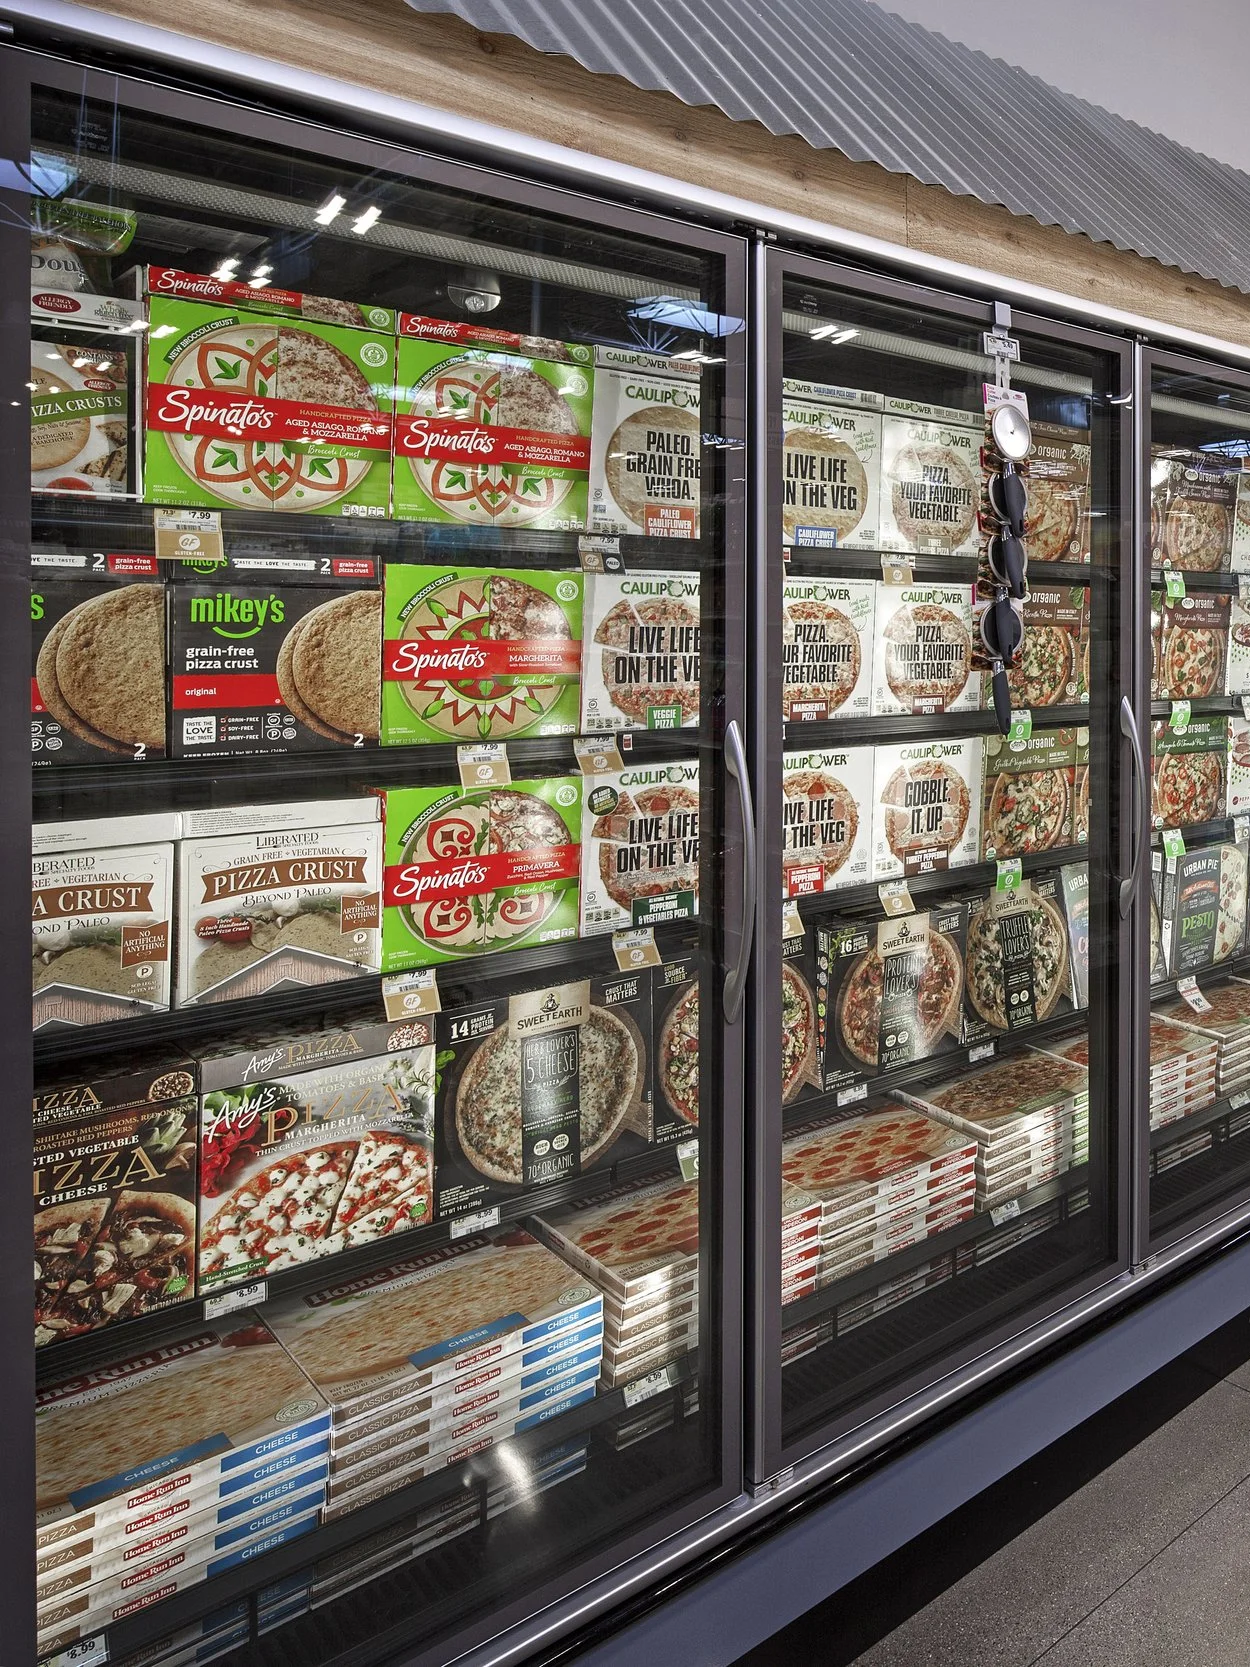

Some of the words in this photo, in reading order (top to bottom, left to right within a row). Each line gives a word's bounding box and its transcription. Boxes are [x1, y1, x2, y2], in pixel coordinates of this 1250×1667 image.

[168, 345, 183, 361] NEW
[182, 325, 210, 347] BROCCOLI
[211, 319, 233, 330] CRUST
[158, 389, 274, 431] Spinato's
[300, 409, 352, 420] HANDCRAFTED
[310, 429, 368, 441] MOZZARELLA
[647, 431, 694, 456] PALEO.
[308, 445, 337, 455] Broccoli
[340, 448, 360, 458] Crust
[504, 443, 525, 452] AGED
[525, 446, 553, 455] ASIAGO,
[554, 449, 585, 459] ROMANO
[787, 452, 819, 480] LIVE
[820, 456, 848, 484] LIFE
[645, 476, 695, 500] WHOA.
[801, 484, 828, 509] THE
[831, 485, 858, 511] VEG
[900, 480, 927, 502] YOUR
[928, 483, 972, 506] FAVORITE
[660, 509, 680, 519] PALEO
[648, 518, 691, 530] CAULIFLOWER
[181, 538, 197, 546] GF
[92, 553, 105, 568] 2
[320, 558, 331, 571] 2
[900, 589, 963, 604] CAULIPOWER
[190, 593, 285, 626] mikey's
[794, 625, 829, 643] PIZZA.
[915, 625, 944, 643] PIZZA.
[185, 645, 255, 659] grain-free
[392, 642, 487, 678] Spinato's
[802, 644, 852, 663] FAVORITE
[894, 644, 921, 662] YOUR
[923, 643, 964, 661] FAVORITE
[185, 658, 222, 671] pizza
[224, 657, 259, 669] crust
[904, 662, 955, 680] VEGETABLE.
[185, 687, 217, 697] original
[653, 709, 676, 719] VEGGIE
[186, 726, 213, 735] LOVE
[655, 719, 674, 729] PIZZA
[1187, 722, 1210, 734] organic
[478, 767, 492, 777] GF
[905, 778, 951, 808] GOBBLE.
[809, 799, 834, 823] LIFE
[629, 817, 663, 844] LIVE
[668, 813, 698, 840] LIFE
[911, 810, 924, 834] IT.
[926, 808, 943, 832] UP.
[255, 831, 319, 848] LIBERATED
[790, 824, 818, 849] THE
[820, 820, 845, 843] VEG
[233, 854, 261, 866] GRAIN
[262, 852, 282, 863] FREE
[291, 847, 340, 857] VEGETARIAN
[512, 861, 560, 873] PRIMAVERA
[1183, 859, 1207, 878] URBAN
[1208, 860, 1218, 870] PIE
[61, 872, 121, 886] VEGETARIAN
[213, 865, 279, 896] PIZZA
[288, 860, 358, 882] CRUST
[393, 860, 488, 900] Spinato's
[58, 887, 142, 913] CRUST
[242, 892, 291, 908] BEYOND
[293, 886, 332, 902] PALEO
[650, 901, 678, 912] PEPPERONI
[1001, 916, 1028, 935] TRUFFLE
[1182, 911, 1214, 939] PESTO
[123, 933, 165, 948] ARTIFICIAL
[124, 941, 165, 953] ANYTHING
[840, 939, 853, 954] 16
[605, 985, 621, 996] CRUST
[623, 980, 637, 991] THAT
[605, 986, 638, 1004] MATTERS
[517, 1011, 552, 1030] SWEET
[553, 1006, 582, 1019] EARTH
[451, 1020, 469, 1039] 14
[241, 1048, 286, 1081] Amy's
[286, 1033, 363, 1065] PIZZA
[527, 1058, 535, 1083] 5
[539, 1049, 575, 1078] CHEESE
[207, 1087, 280, 1143] Amy's
[255, 1147, 278, 1157] THIN
[279, 1139, 305, 1152] CRUST
[307, 1130, 340, 1143] TOPPED
[341, 1124, 363, 1135] WITH
[364, 1112, 414, 1129] MOZZARELLA
[285, 1113, 366, 1141] MARGHERITA
[33, 1138, 75, 1152] ROASTED
[77, 1133, 95, 1143] RED
[96, 1125, 133, 1139] PEPPERS
[69, 1135, 139, 1158] VEGETABLE
[39, 1182, 108, 1206] CHEESE
[309, 1275, 385, 1305] Home
[388, 1251, 440, 1279] Run
[442, 1235, 485, 1256] Inn
[347, 1389, 392, 1415] CLASSIC
[393, 1379, 421, 1397] PIZZA
[455, 1358, 473, 1370] Home
[474, 1352, 487, 1364] Run
[487, 1345, 501, 1357] Inn
[546, 1311, 580, 1331] CHEESE
[348, 1414, 392, 1440] CLASSIC
[392, 1403, 420, 1421] PIZZA
[546, 1334, 580, 1354] CHEESE
[345, 1439, 390, 1465] CLASSIC
[391, 1426, 420, 1447] PIZZA
[545, 1356, 579, 1376] CHEESE
[37, 1525, 77, 1546] PIZZA
[127, 1491, 153, 1508] Home
[153, 1483, 171, 1497] Run
[172, 1475, 190, 1490] Inn
[255, 1430, 299, 1455] CHEESE
[251, 1479, 295, 1505] CHEESE
